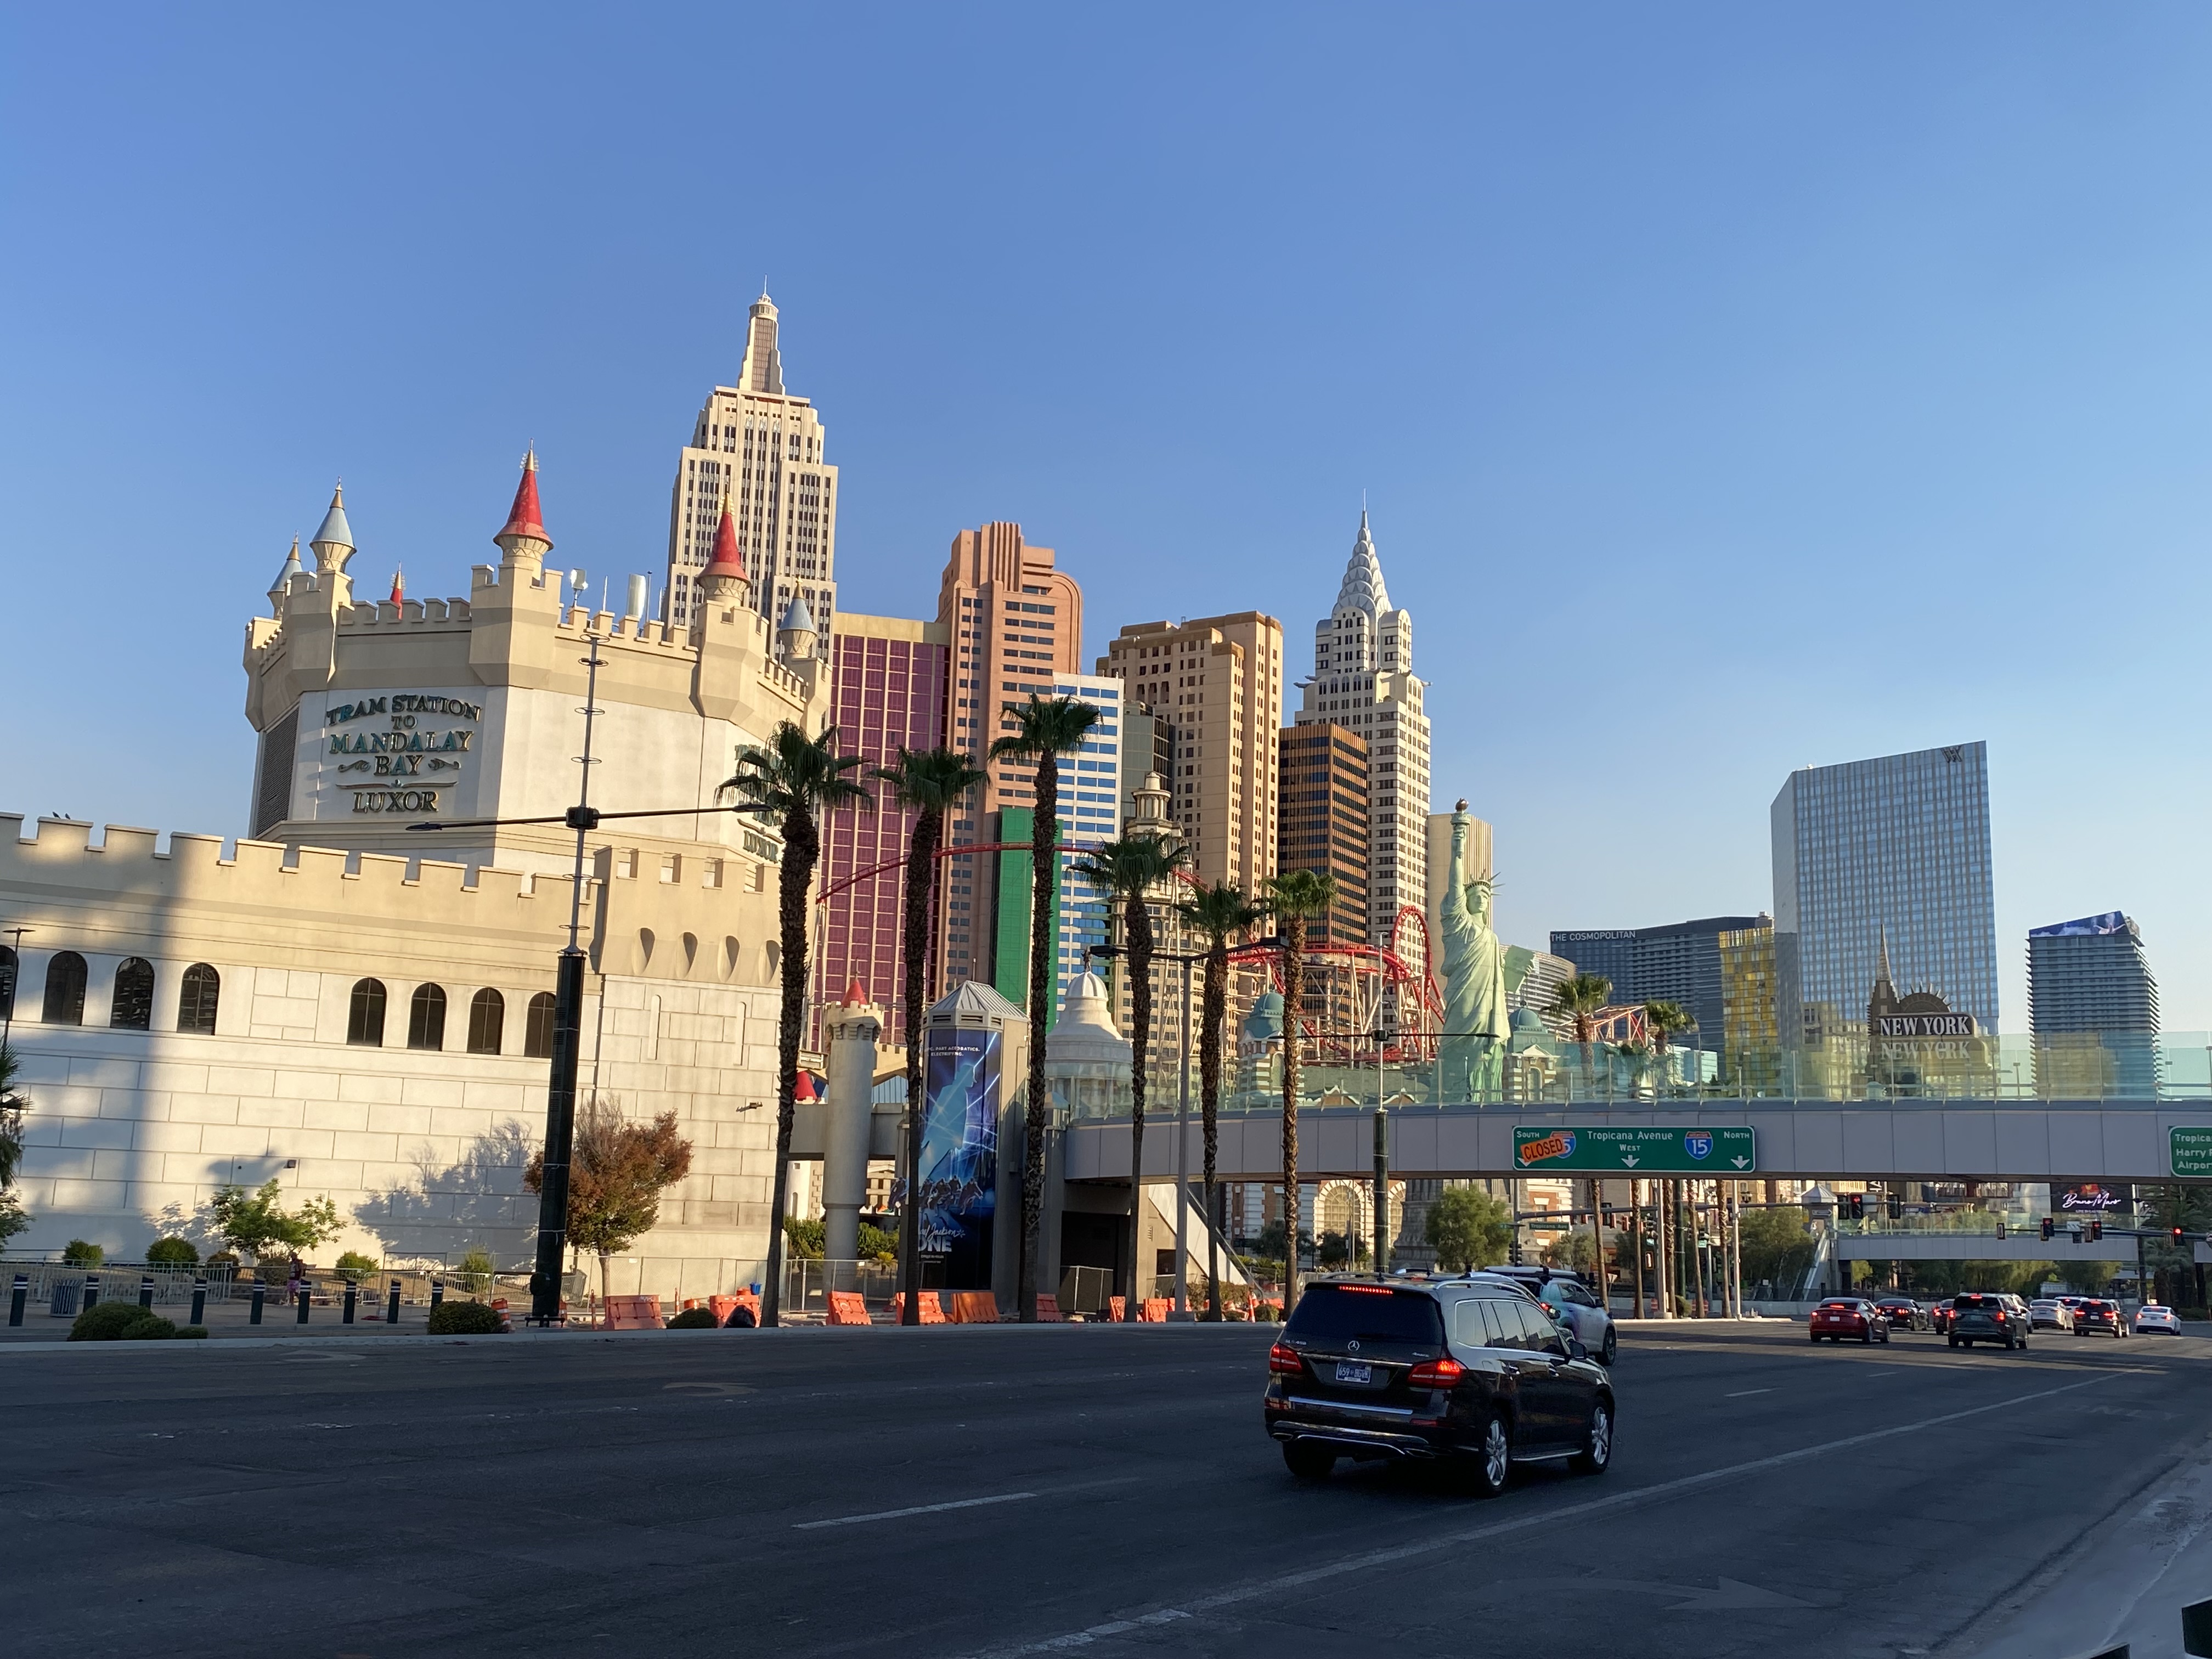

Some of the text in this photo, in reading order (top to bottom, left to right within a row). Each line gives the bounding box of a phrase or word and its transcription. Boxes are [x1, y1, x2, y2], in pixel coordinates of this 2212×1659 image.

[326, 694, 483, 726] TRAM STATION
[391, 715, 417, 730] TO
[329, 731, 475, 754] MANDALAY
[374, 754, 424, 776] BAY
[352, 791, 439, 813] LUXOR
[1551, 930, 1636, 941] THE COSMOPOLITAN
[1880, 1016, 1971, 1036] NEW YORK
[1881, 1041, 1971, 1060] NEW YORK
[1587, 1131, 1673, 1142] Tropicana Avenue
[1724, 1131, 1750, 1139] NORTH
[2175, 1133, 2212, 1144] Tropica
[1524, 1138, 1563, 1160] CLOSED
[1692, 1139, 1708, 1155] 15
[2176, 1148, 2207, 1159] Harry
[2177, 1160, 2212, 1171] Airpor
[918, 1235, 952, 1252] ONE
